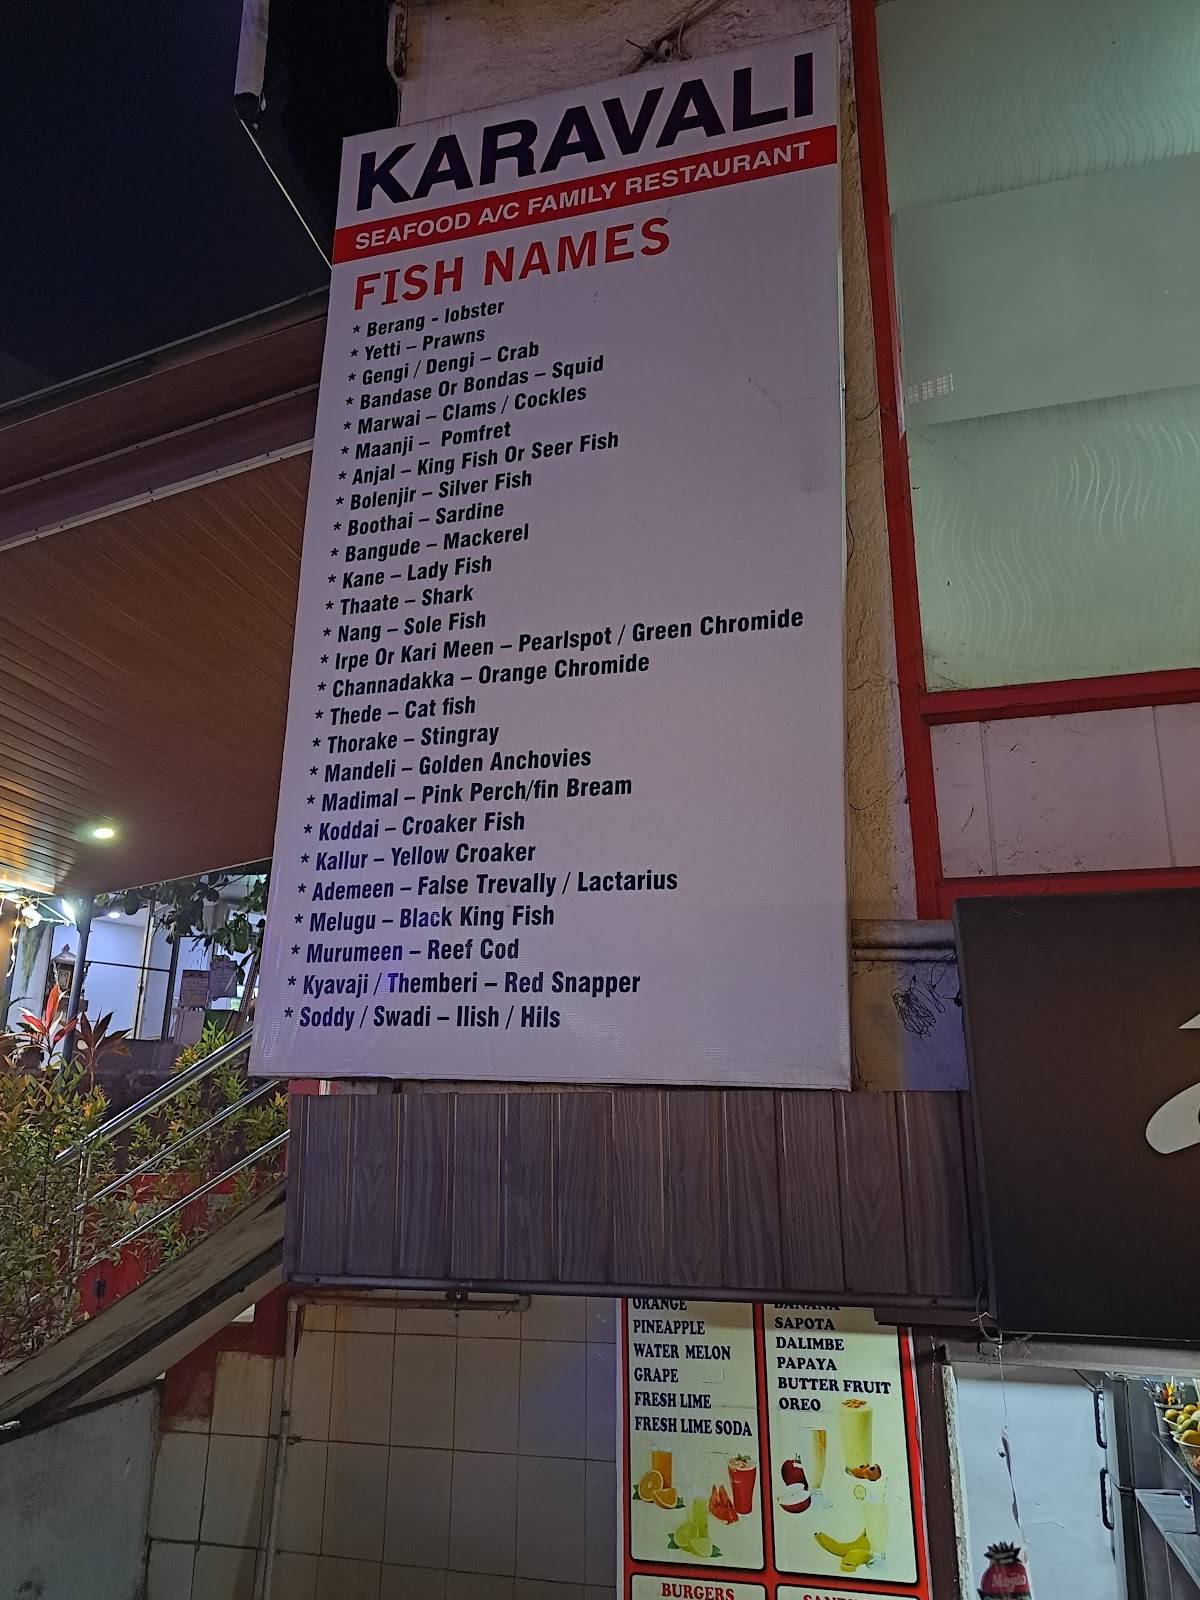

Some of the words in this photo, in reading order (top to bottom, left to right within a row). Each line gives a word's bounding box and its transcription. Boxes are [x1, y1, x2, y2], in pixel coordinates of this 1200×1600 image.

[356, 52, 813, 211] KARAVALI
[356, 213, 470, 250] SEAFOOD
[479, 201, 520, 223] A/C
[528, 182, 615, 214] FAMILY
[625, 141, 811, 195] RESTAURANT
[354, 256, 463, 310] FISH
[484, 217, 670, 286] NAMES
[366, 316, 425, 338] Berang
[445, 301, 505, 324] lobster
[365, 340, 401, 361] Yetti
[422, 329, 485, 351] Prawns
[362, 363, 409, 385] Gengi
[426, 351, 475, 375] Dengi
[497, 341, 539, 362] Crab
[360, 387, 432, 410] Bandase
[438, 380, 458, 397] Or
[464, 370, 528, 393] Bondas
[552, 355, 604, 380] Squid
[357, 409, 420, 435] Marwai
[443, 401, 496, 421] Clams
[515, 386, 587, 410] Cockles
[355, 435, 414, 460] Maanji
[441, 421, 511, 447] Pomfret
[352, 463, 395, 486] Anjal
[417, 457, 455, 476] King
[461, 449, 498, 470] Fish
[505, 445, 525, 463] Or
[531, 441, 573, 459] Seer
[580, 431, 618, 452] Fish
[350, 486, 416, 510] Bolenjir
[438, 479, 488, 498] Silver
[495, 470, 532, 491] Fish
[347, 512, 413, 536] Boothai
[435, 502, 504, 525] Sardine
[345, 538, 420, 562] Bangude
[443, 523, 529, 550] Mackerel
[342, 571, 385, 589] Kane
[407, 561, 449, 582] Lady
[454, 555, 492, 576] Fish
[340, 594, 399, 615] Thaate
[421, 584, 474, 606] Shark
[335, 653, 369, 673] Irpe
[375, 647, 395, 666] Or
[401, 642, 437, 663] Kari
[443, 640, 494, 659] Meen
[519, 627, 612, 652] Pearlspot
[632, 622, 692, 642] Green
[700, 608, 803, 636] Chromide
[338, 625, 381, 643] Nang
[404, 616, 442, 636] Sole
[448, 610, 486, 631] Fish
[333, 670, 454, 698] Channadakka
[479, 665, 547, 685] Orange
[554, 653, 649, 678] Chromide
[330, 704, 382, 726] Thede
[405, 699, 436, 719] Cat
[442, 696, 475, 716] fish
[327, 732, 398, 754] Thorake
[421, 726, 500, 748] Stingray
[324, 759, 396, 783] Mandeli
[419, 754, 483, 775] Golden
[490, 748, 591, 771] Anchovies
[321, 788, 399, 812] Madimal
[422, 784, 464, 804] Pink
[470, 779, 558, 802] Perch/fin
[566, 778, 632, 797] Bream
[319, 818, 379, 841] Koddai
[402, 813, 477, 836] Croaker
[484, 811, 525, 831] Fish
[316, 850, 368, 871] Kallur
[391, 845, 450, 866] Yellow
[456, 842, 536, 863] Croaker
[312, 881, 394, 901] Ademeen
[418, 875, 468, 896] False
[476, 872, 557, 897] Trevally
[578, 869, 677, 892] Lactarius
[309, 911, 376, 935] Melugu
[400, 906, 453, 928] Black
[460, 906, 504, 931] King
[512, 905, 554, 926] Fish
[306, 943, 403, 963] Murumeen
[427, 938, 473, 960] Reef
[480, 938, 519, 959] Cod
[303, 973, 369, 999] Kyavaji
[387, 972, 478, 993] Themberi
[504, 971, 544, 993] Red
[551, 971, 640, 998] Snapper
[299, 1006, 355, 1031] Soddy
[373, 1005, 431, 1027] Swadi
[457, 1005, 499, 1027] Ilish
[521, 1006, 560, 1028] Hils
[633, 1297, 688, 1311] ORANGE
[633, 1319, 705, 1335] PINEAPPLE
[774, 1316, 836, 1331] SAPOTA
[633, 1343, 679, 1359] WATER
[685, 1344, 731, 1360] MELON
[775, 1336, 845, 1351] DALIMBE
[633, 1367, 679, 1383] GRAPE
[776, 1356, 838, 1371] PAPAYA
[634, 1391, 676, 1408] FRESH
[680, 1393, 712, 1409] LIME
[777, 1376, 840, 1392] BUTTER
[842, 1379, 891, 1395] FRUIT
[778, 1397, 821, 1411] OREO
[634, 1416, 677, 1433] FRESH
[680, 1418, 712, 1434] LIME
[714, 1420, 752, 1437] SODA
[661, 1582, 735, 1600] BURGERS
